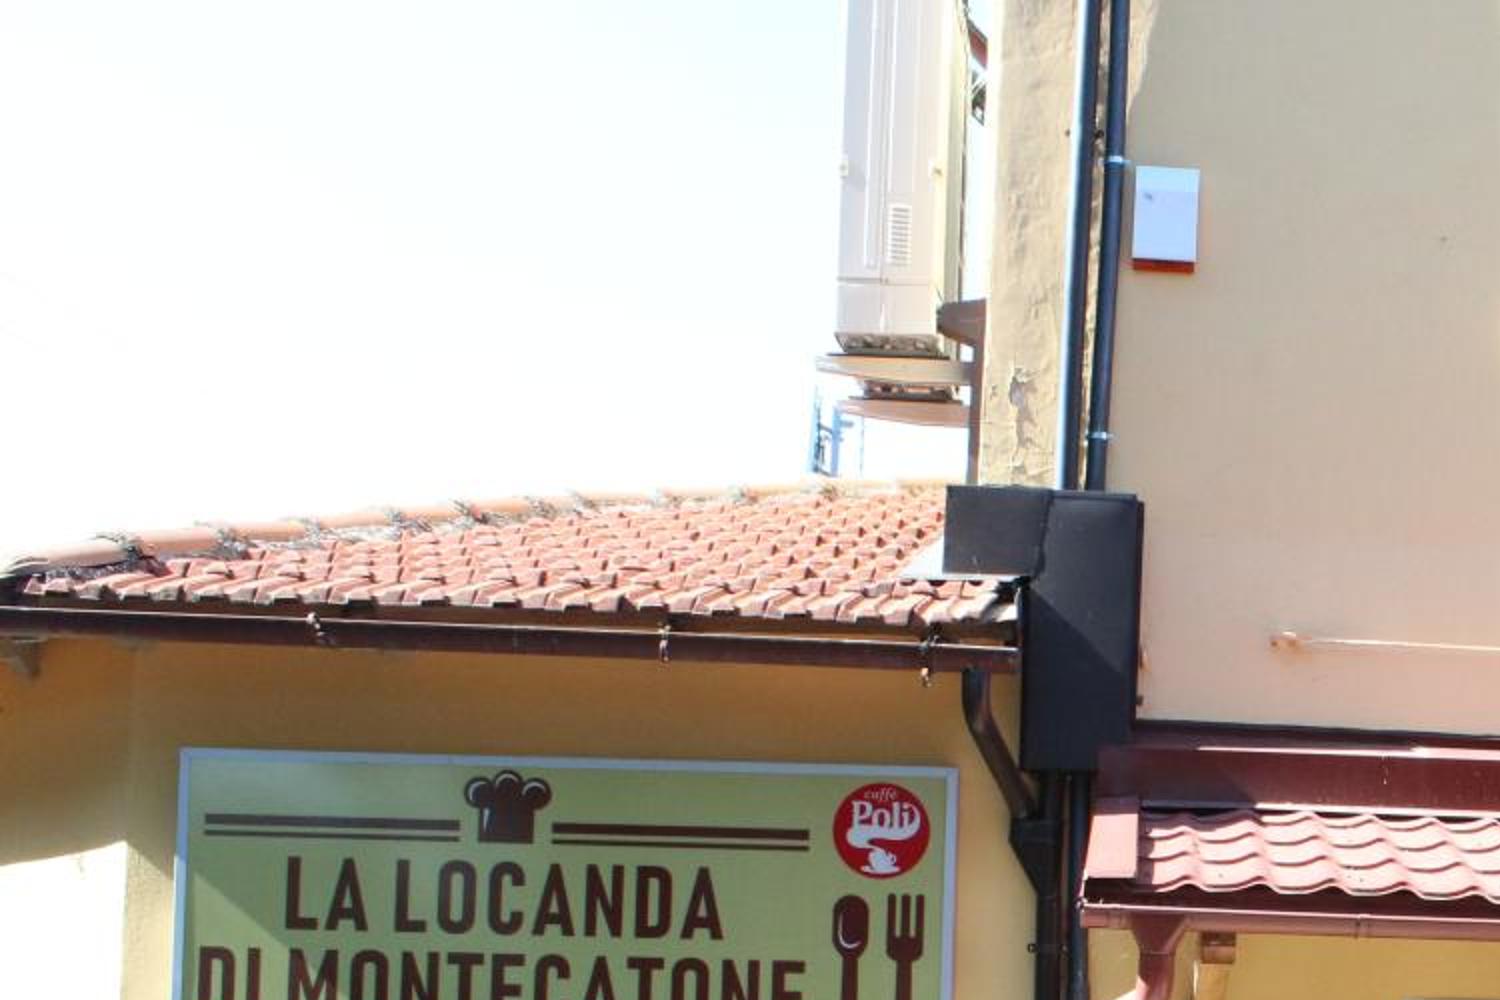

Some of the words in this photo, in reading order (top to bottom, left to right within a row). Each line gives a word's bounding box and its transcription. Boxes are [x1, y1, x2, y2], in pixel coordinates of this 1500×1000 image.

[849, 799, 920, 838] Poli
[284, 856, 369, 932] LA
[394, 859, 724, 941] LOCANDA
